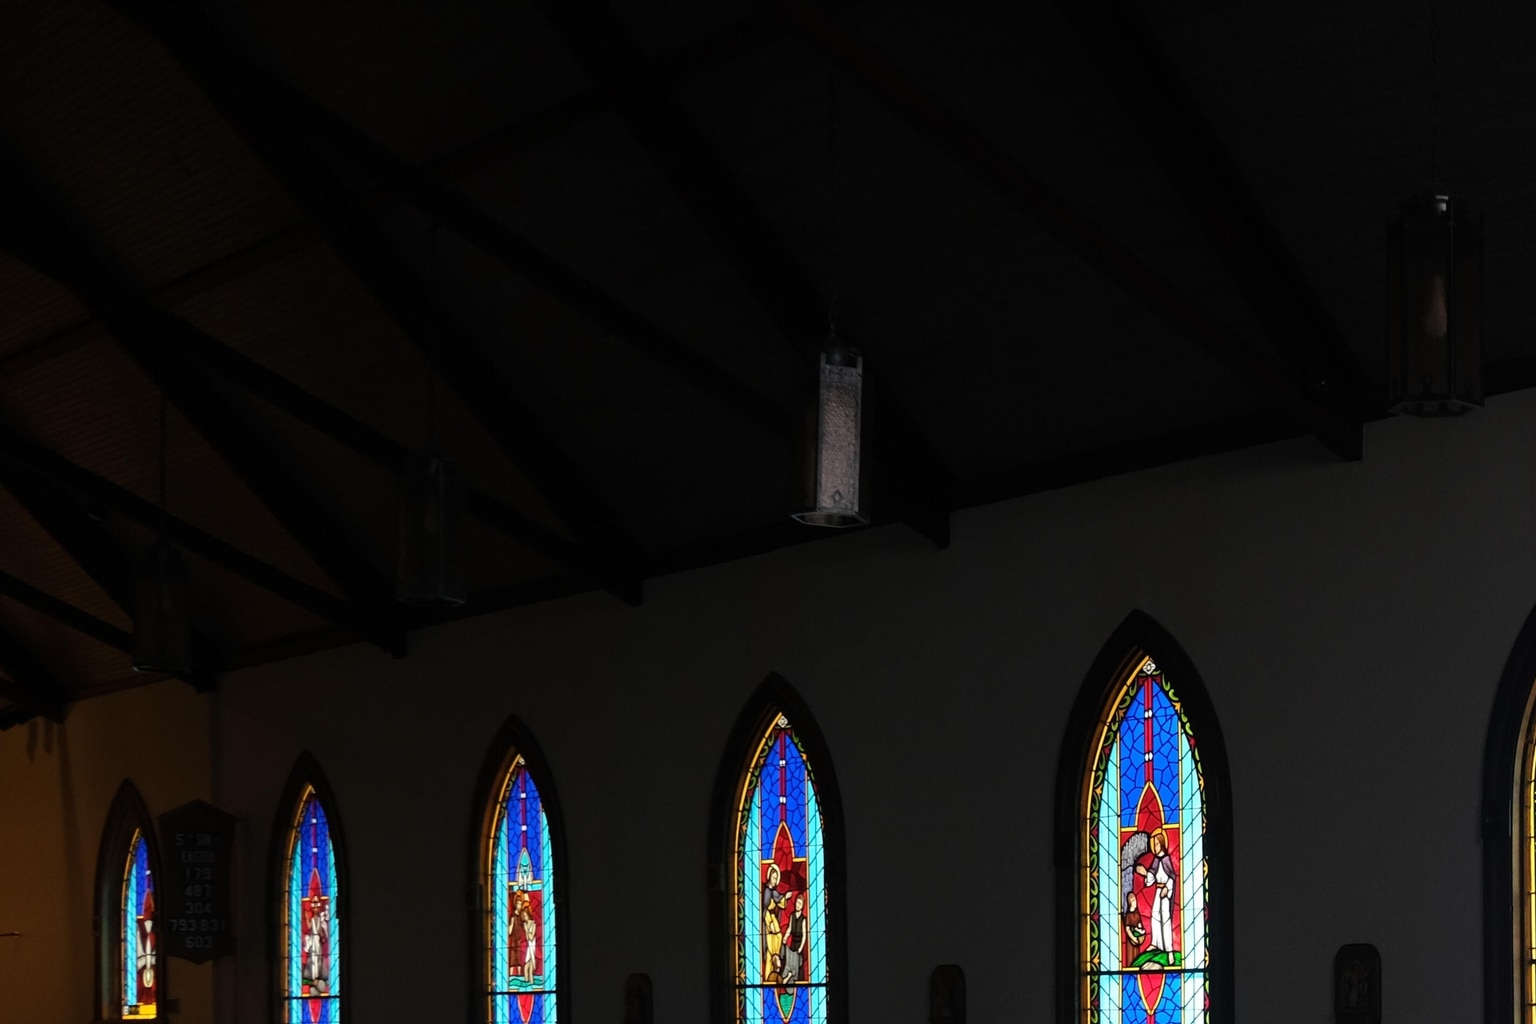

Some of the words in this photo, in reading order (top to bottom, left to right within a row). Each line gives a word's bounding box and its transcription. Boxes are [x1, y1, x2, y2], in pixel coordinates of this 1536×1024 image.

[185, 867, 212, 880] 179
[185, 884, 212, 897] 487
[185, 901, 212, 914] 304
[169, 918, 197, 931] 793
[185, 935, 213, 948] 603
